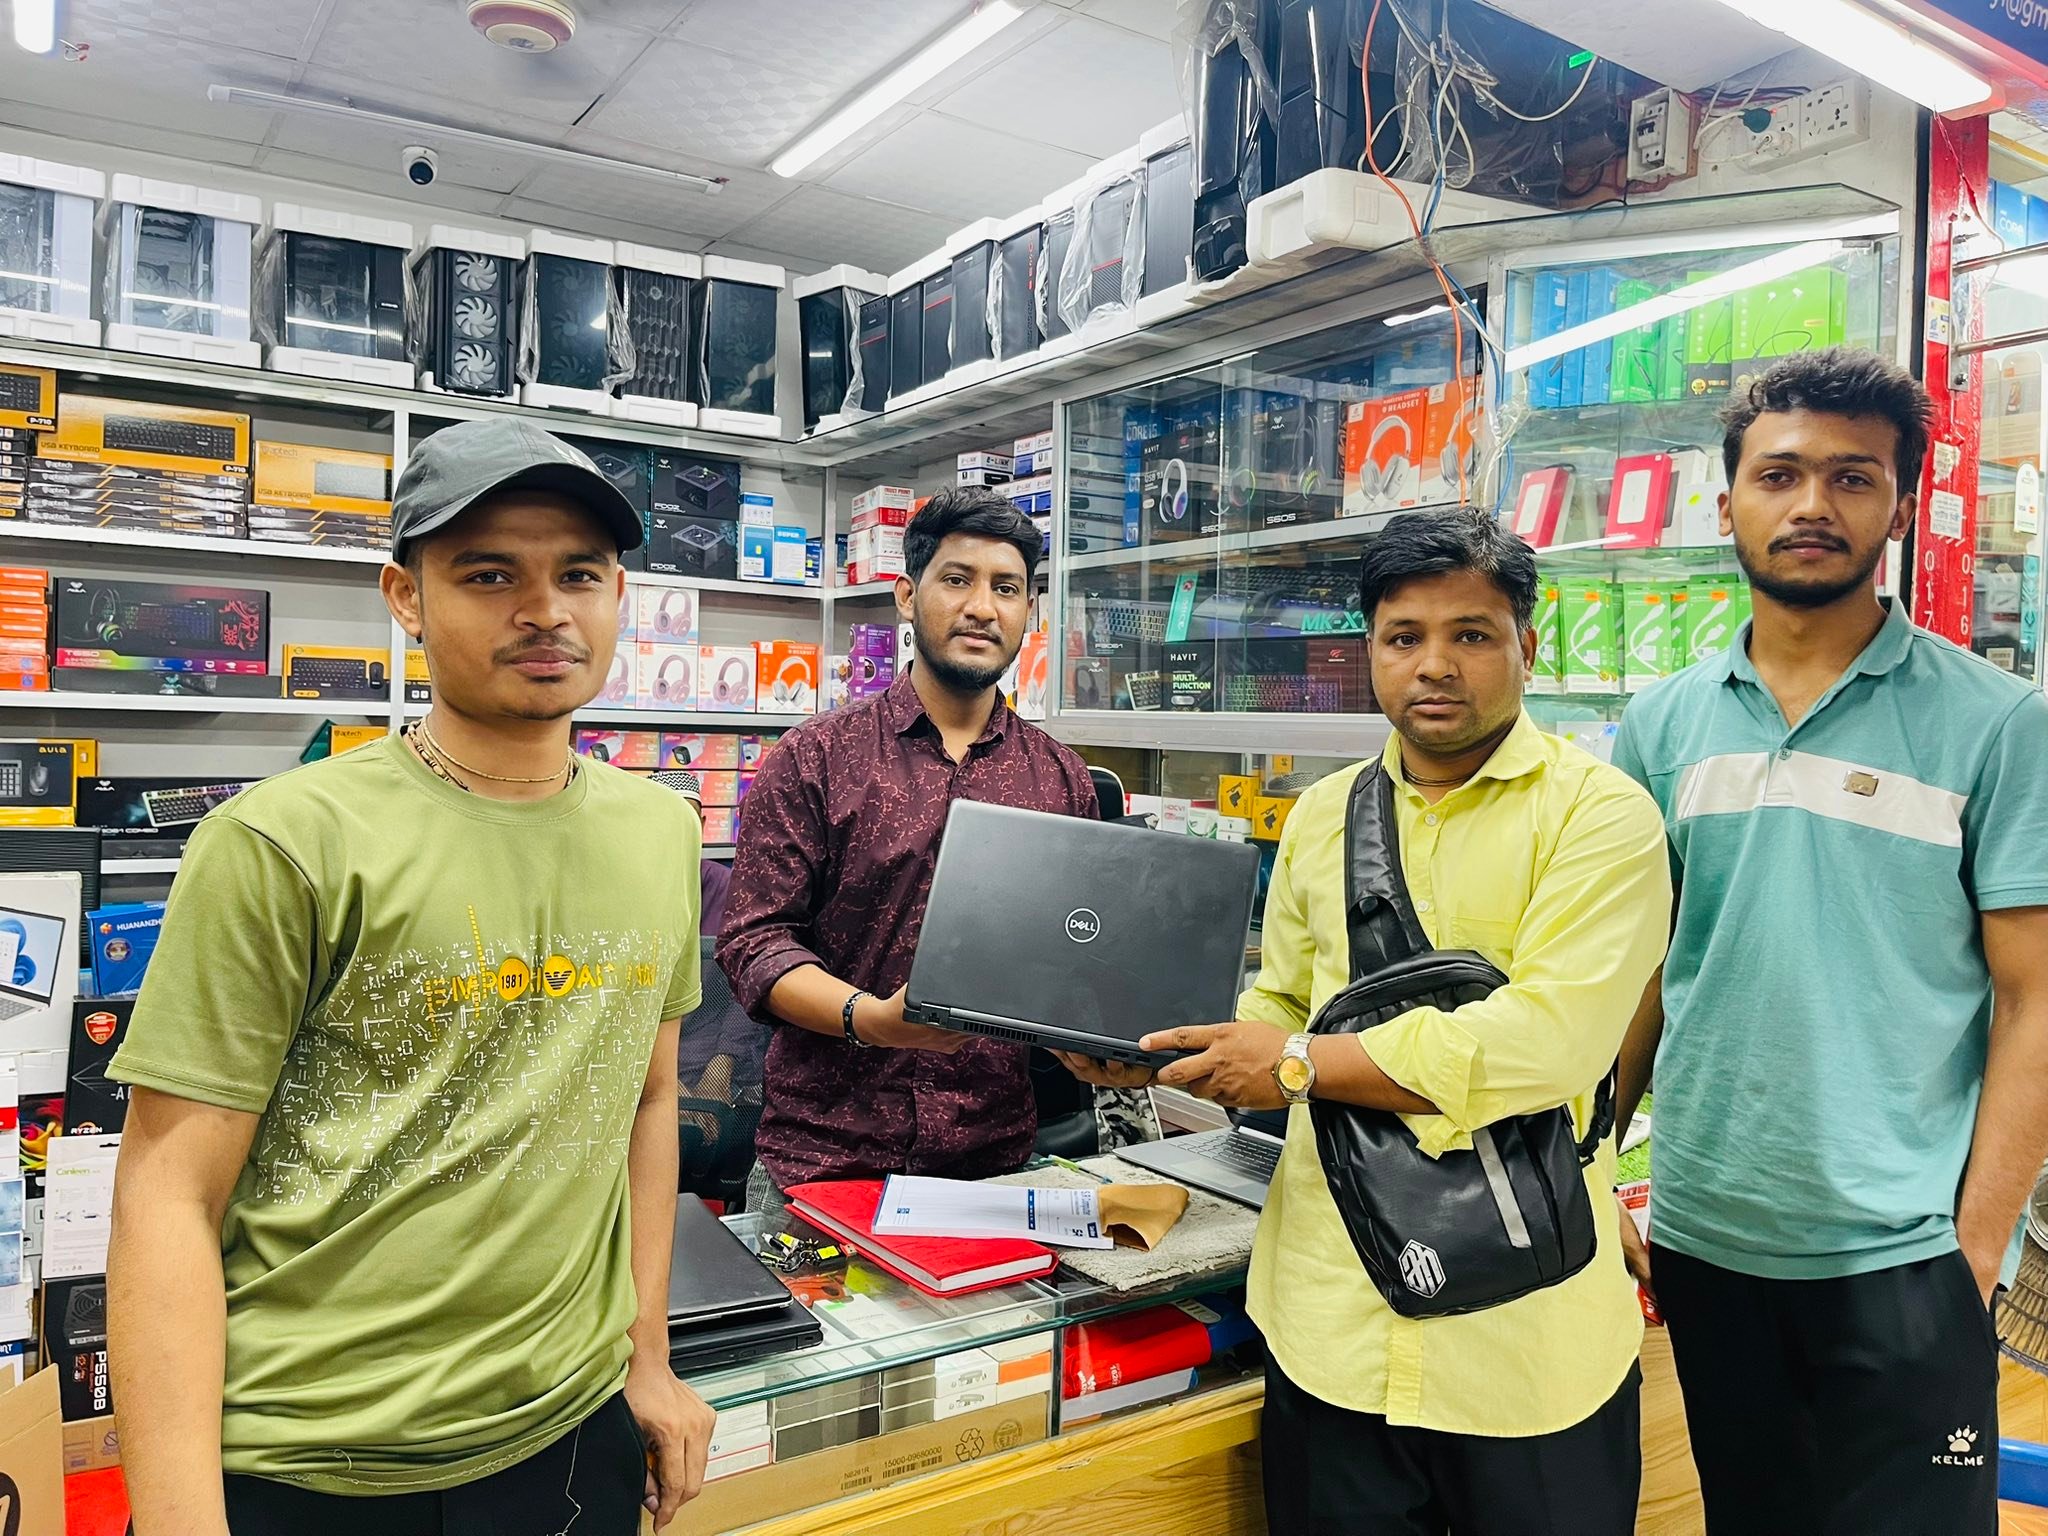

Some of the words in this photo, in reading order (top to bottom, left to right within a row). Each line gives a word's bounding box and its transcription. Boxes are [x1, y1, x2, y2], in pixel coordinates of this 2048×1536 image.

[1388, 399, 1419, 412] HEADSET
[29, 416, 53, 425] P-710
[1126, 422, 1148, 442] CORE
[41, 441, 57, 449] USB
[58, 444, 100, 453] KEYBOARD
[225, 465, 247, 474] P-710
[1170, 653, 1198, 661] HAVIT
[1172, 673, 1198, 682] MULTI-
[1172, 682, 1211, 690] FUNCTION
[116, 919, 162, 931] HUANANZH
[1069, 918, 1096, 932] DELL
[501, 973, 523, 990] 1981
[70, 1126, 103, 1134] RYZEN
[1931, 1455, 1985, 1467] KELME
